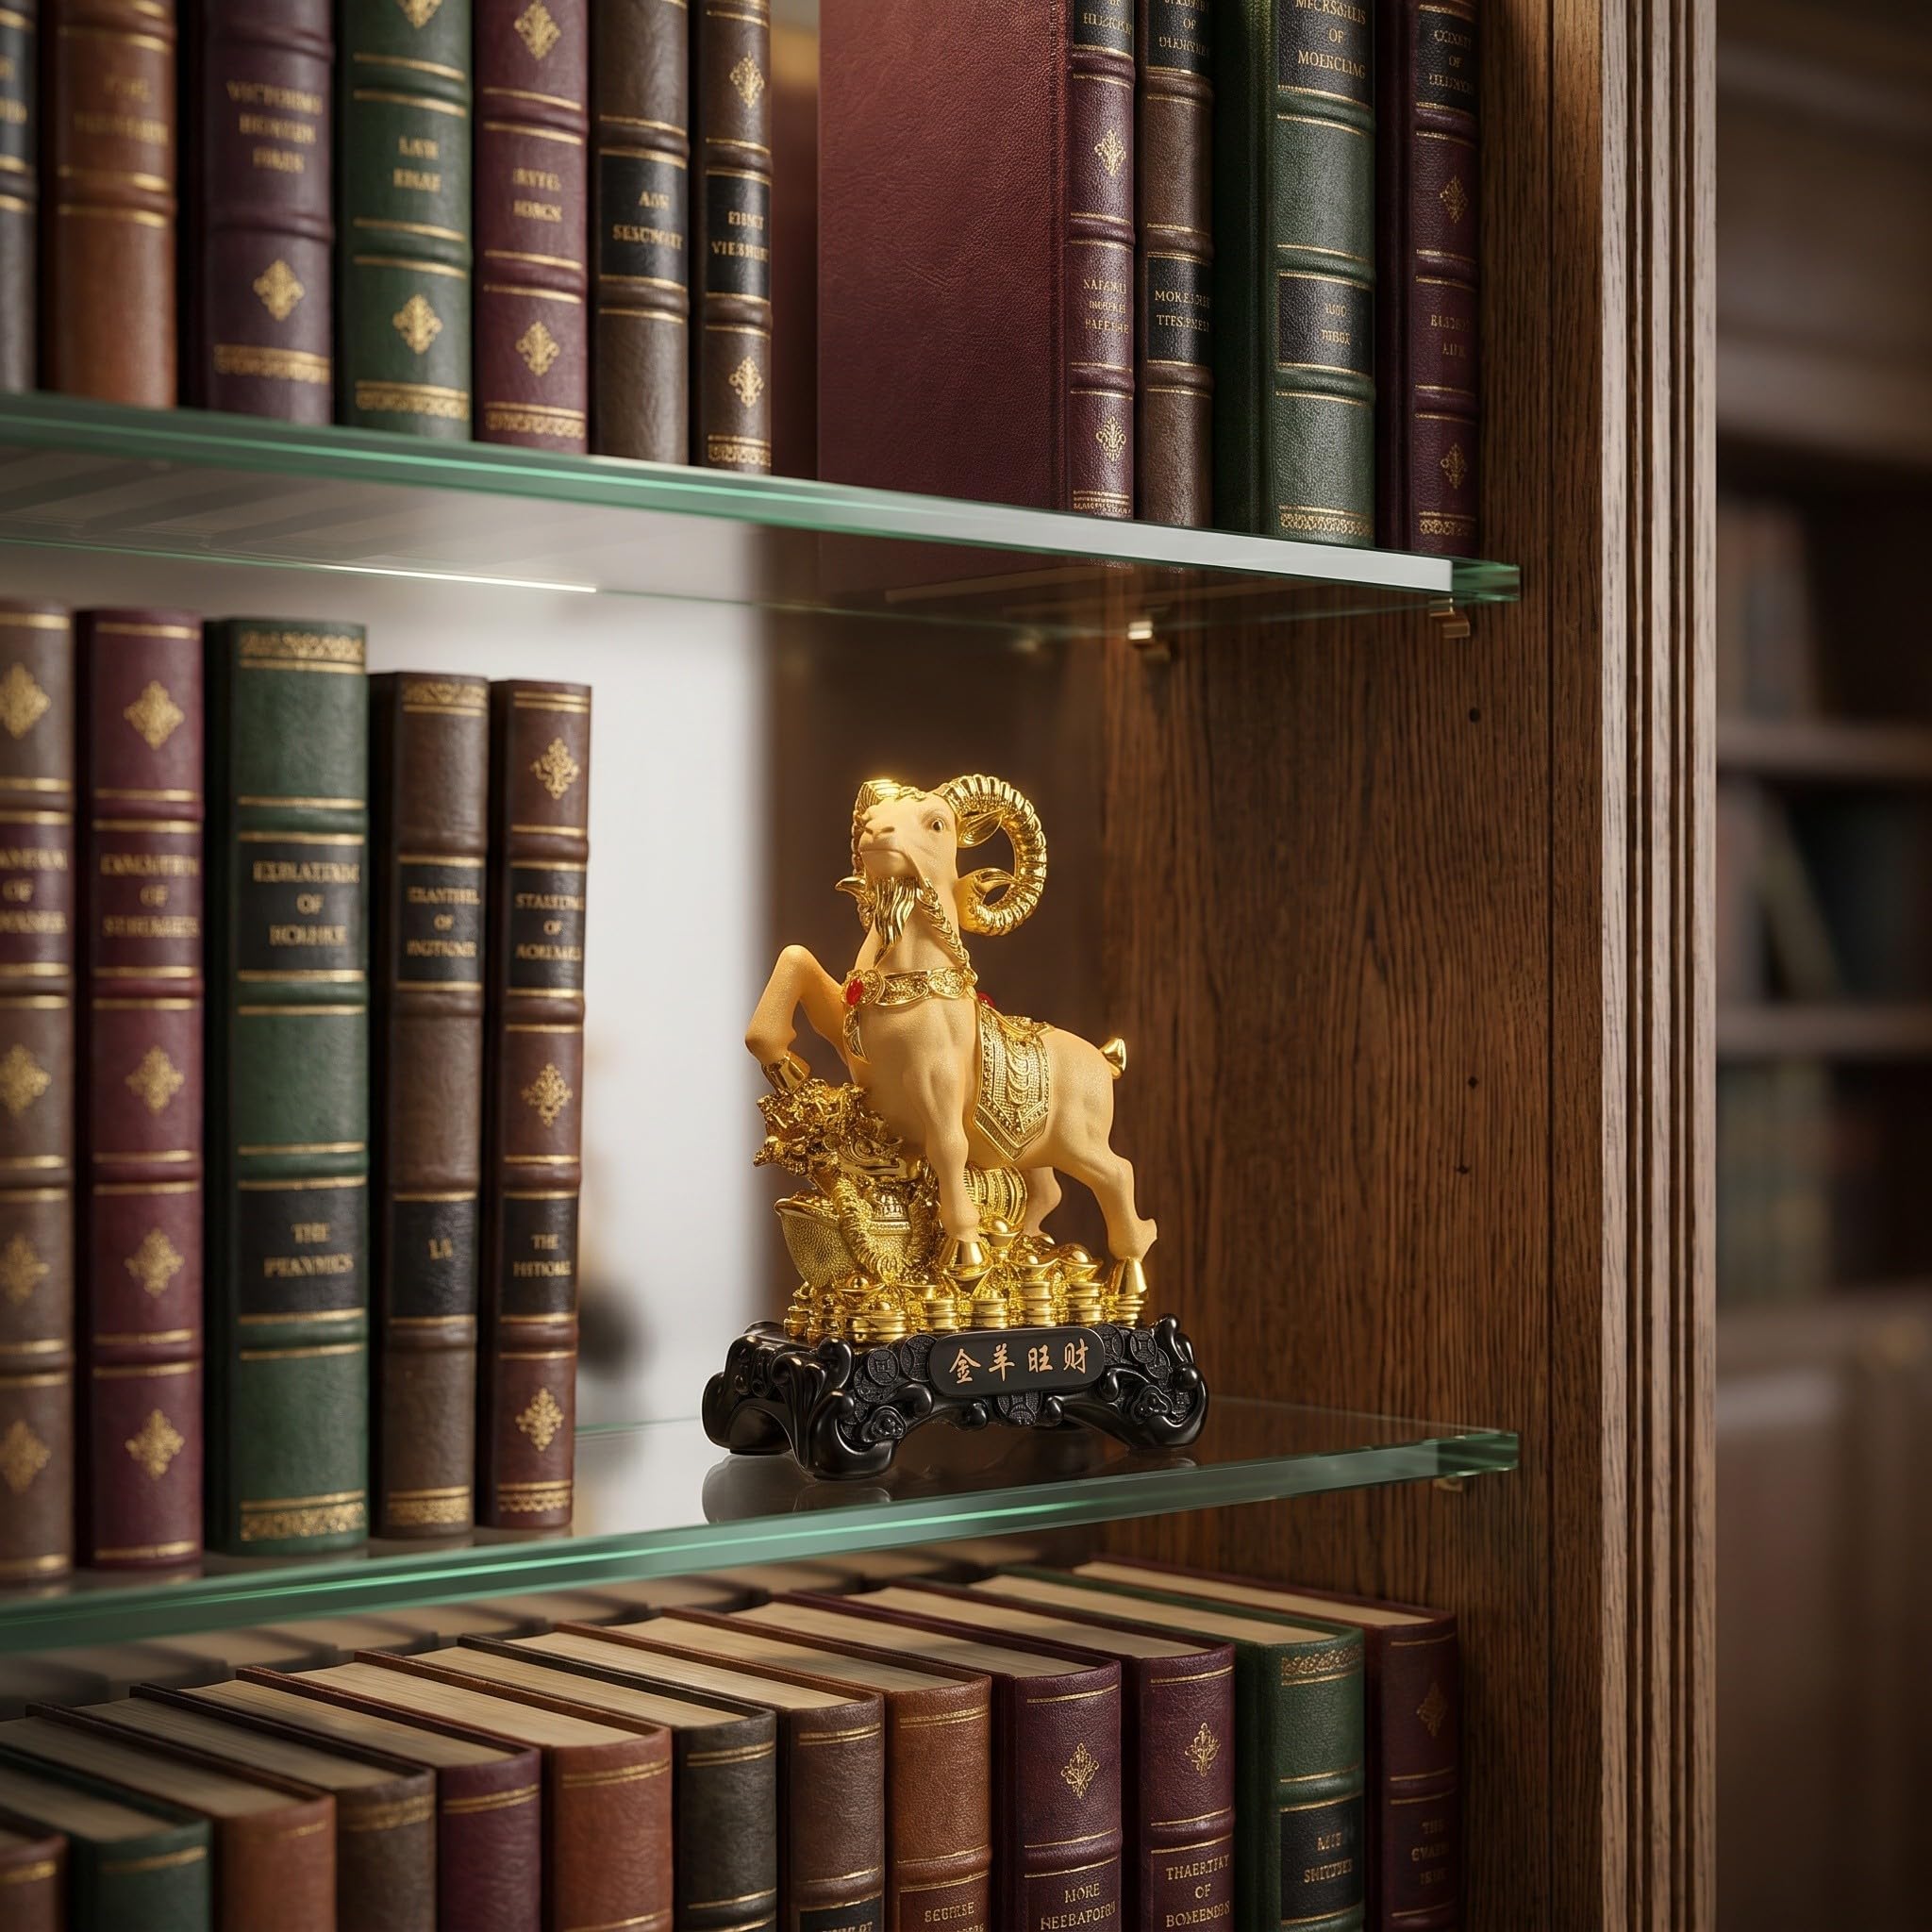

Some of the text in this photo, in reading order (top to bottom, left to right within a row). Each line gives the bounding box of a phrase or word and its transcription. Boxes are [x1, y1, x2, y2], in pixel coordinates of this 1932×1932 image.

[1328, 28, 1344, 43] OF
[297, 893, 325, 915] OF
[949, 1338, 1089, 1384] 金羊旺财
[1065, 1883, 1100, 1904] MORE
[1194, 1883, 1211, 1899] OF
